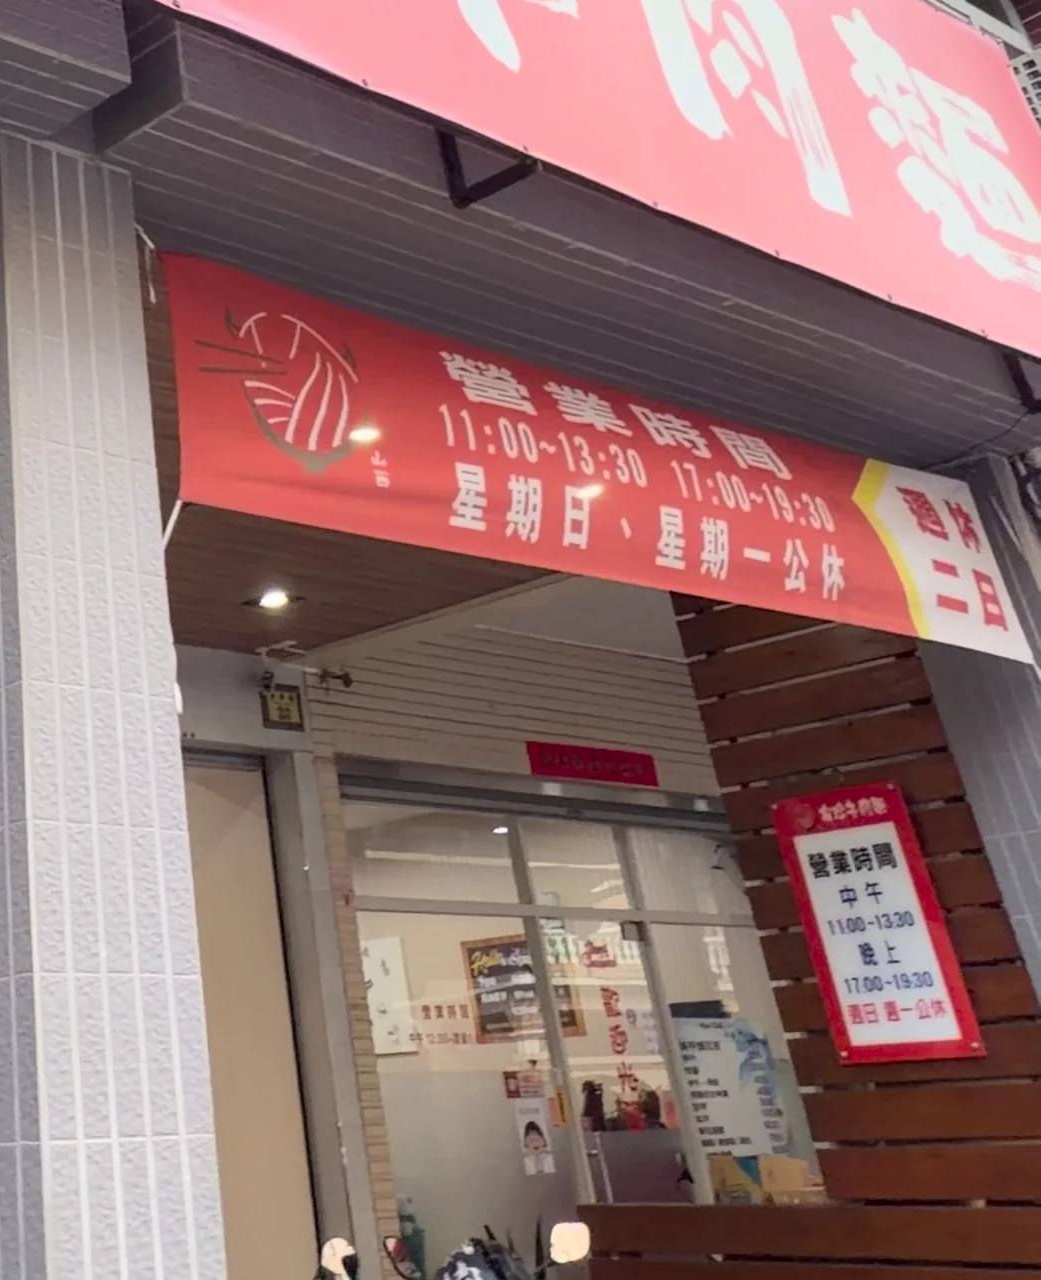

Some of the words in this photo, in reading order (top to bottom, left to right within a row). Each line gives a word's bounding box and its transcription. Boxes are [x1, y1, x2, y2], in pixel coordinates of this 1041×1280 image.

[439, 350, 793, 481] 營業時間
[438, 403, 648, 488] 11:00~13:30
[670, 459, 835, 533] 17:00~19:30
[449, 461, 846, 602] 星期日、星期一公休
[895, 485, 981, 553] 週休
[931, 558, 1009, 632] 二日
[807, 842, 897, 879] 營業時間
[839, 881, 883, 908] 中午
[858, 939, 901, 966] 晚上
